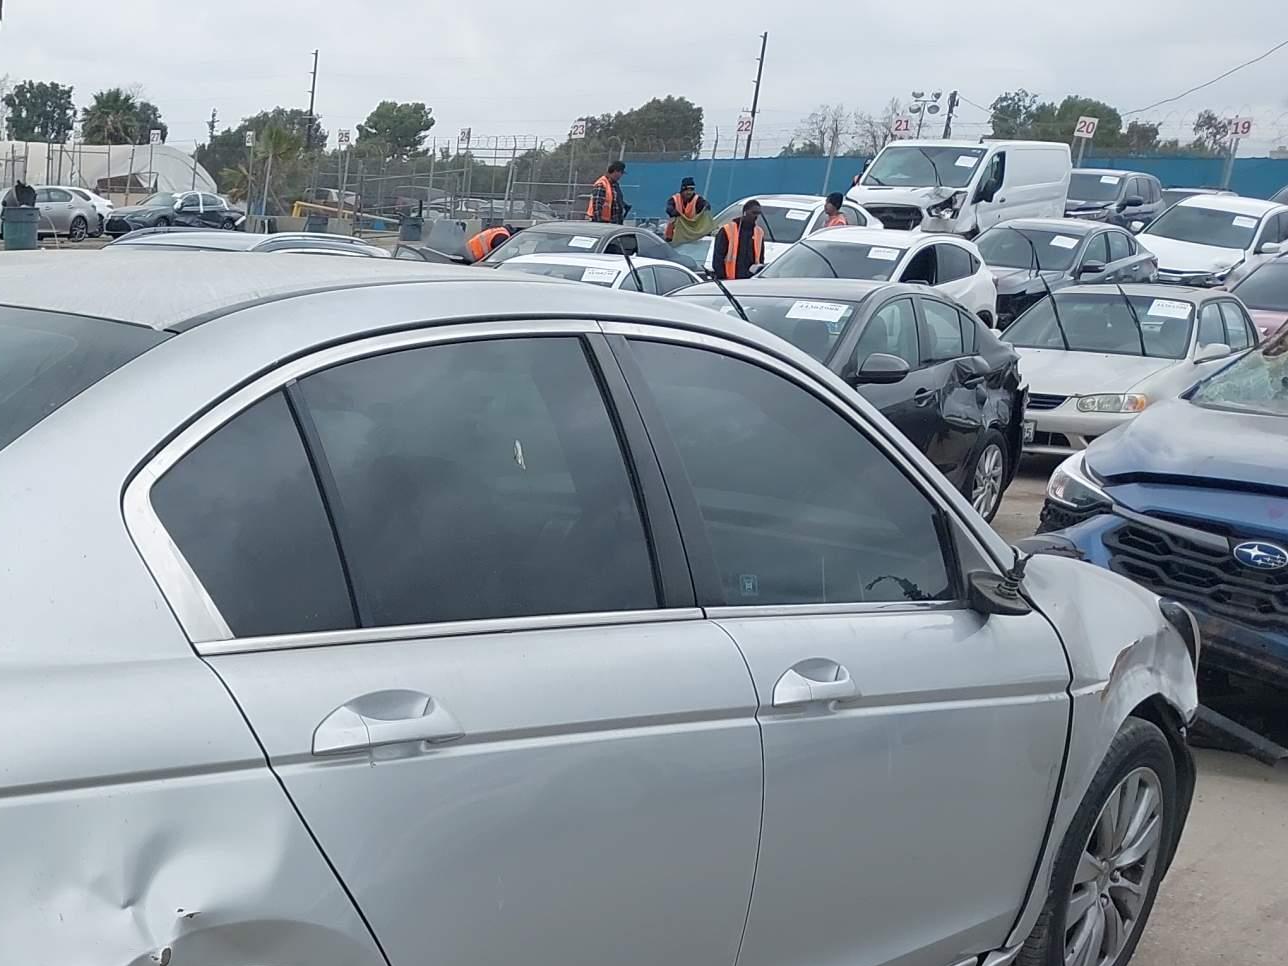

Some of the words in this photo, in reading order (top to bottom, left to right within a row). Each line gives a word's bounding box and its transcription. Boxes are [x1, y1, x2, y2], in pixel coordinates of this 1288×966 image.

[572, 124, 585, 136] 23
[737, 120, 751, 132] 22
[895, 119, 910, 132] 21
[1076, 120, 1096, 134] 20
[1231, 120, 1251, 135] 19
[338, 132, 350, 142] 25
